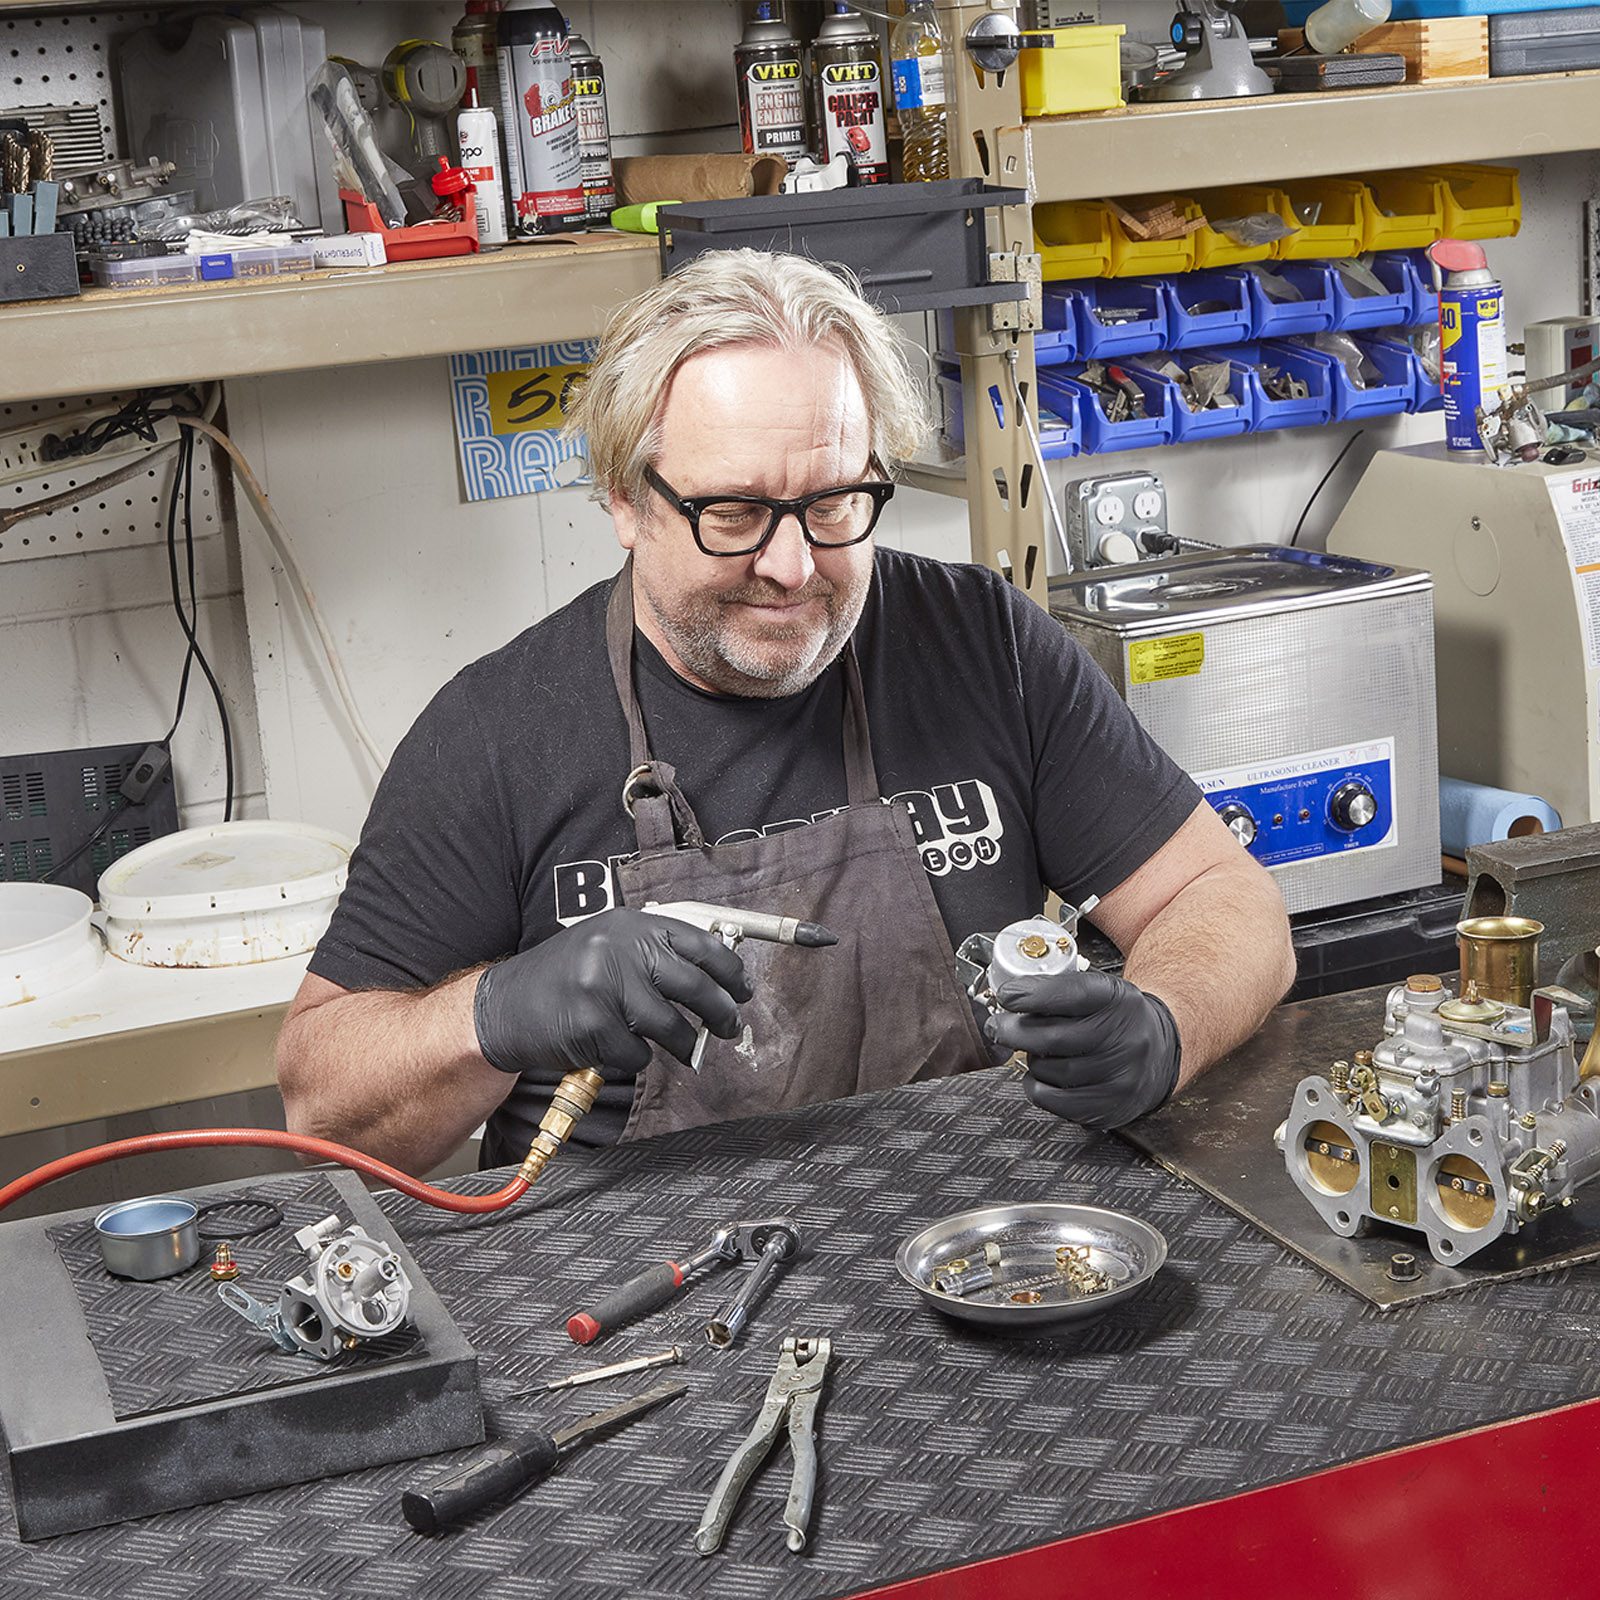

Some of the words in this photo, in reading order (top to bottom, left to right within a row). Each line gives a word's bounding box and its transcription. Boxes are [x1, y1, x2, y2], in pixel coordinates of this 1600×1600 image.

[756, 62, 798, 80] VHT
[830, 65, 873, 82] VHT
[574, 79, 600, 95] HT
[828, 92, 879, 112] CALIPER
[531, 104, 571, 135] BRAKE
[836, 110, 875, 128] PAINT
[766, 131, 801, 144] PRIMER
[461, 147, 483, 159] ppo
[1572, 478, 1600, 494] Griz
[1247, 765, 1301, 782] ULTRASONIC
[1302, 756, 1341, 773] CLEANER
[920, 836, 1000, 873] ECH
